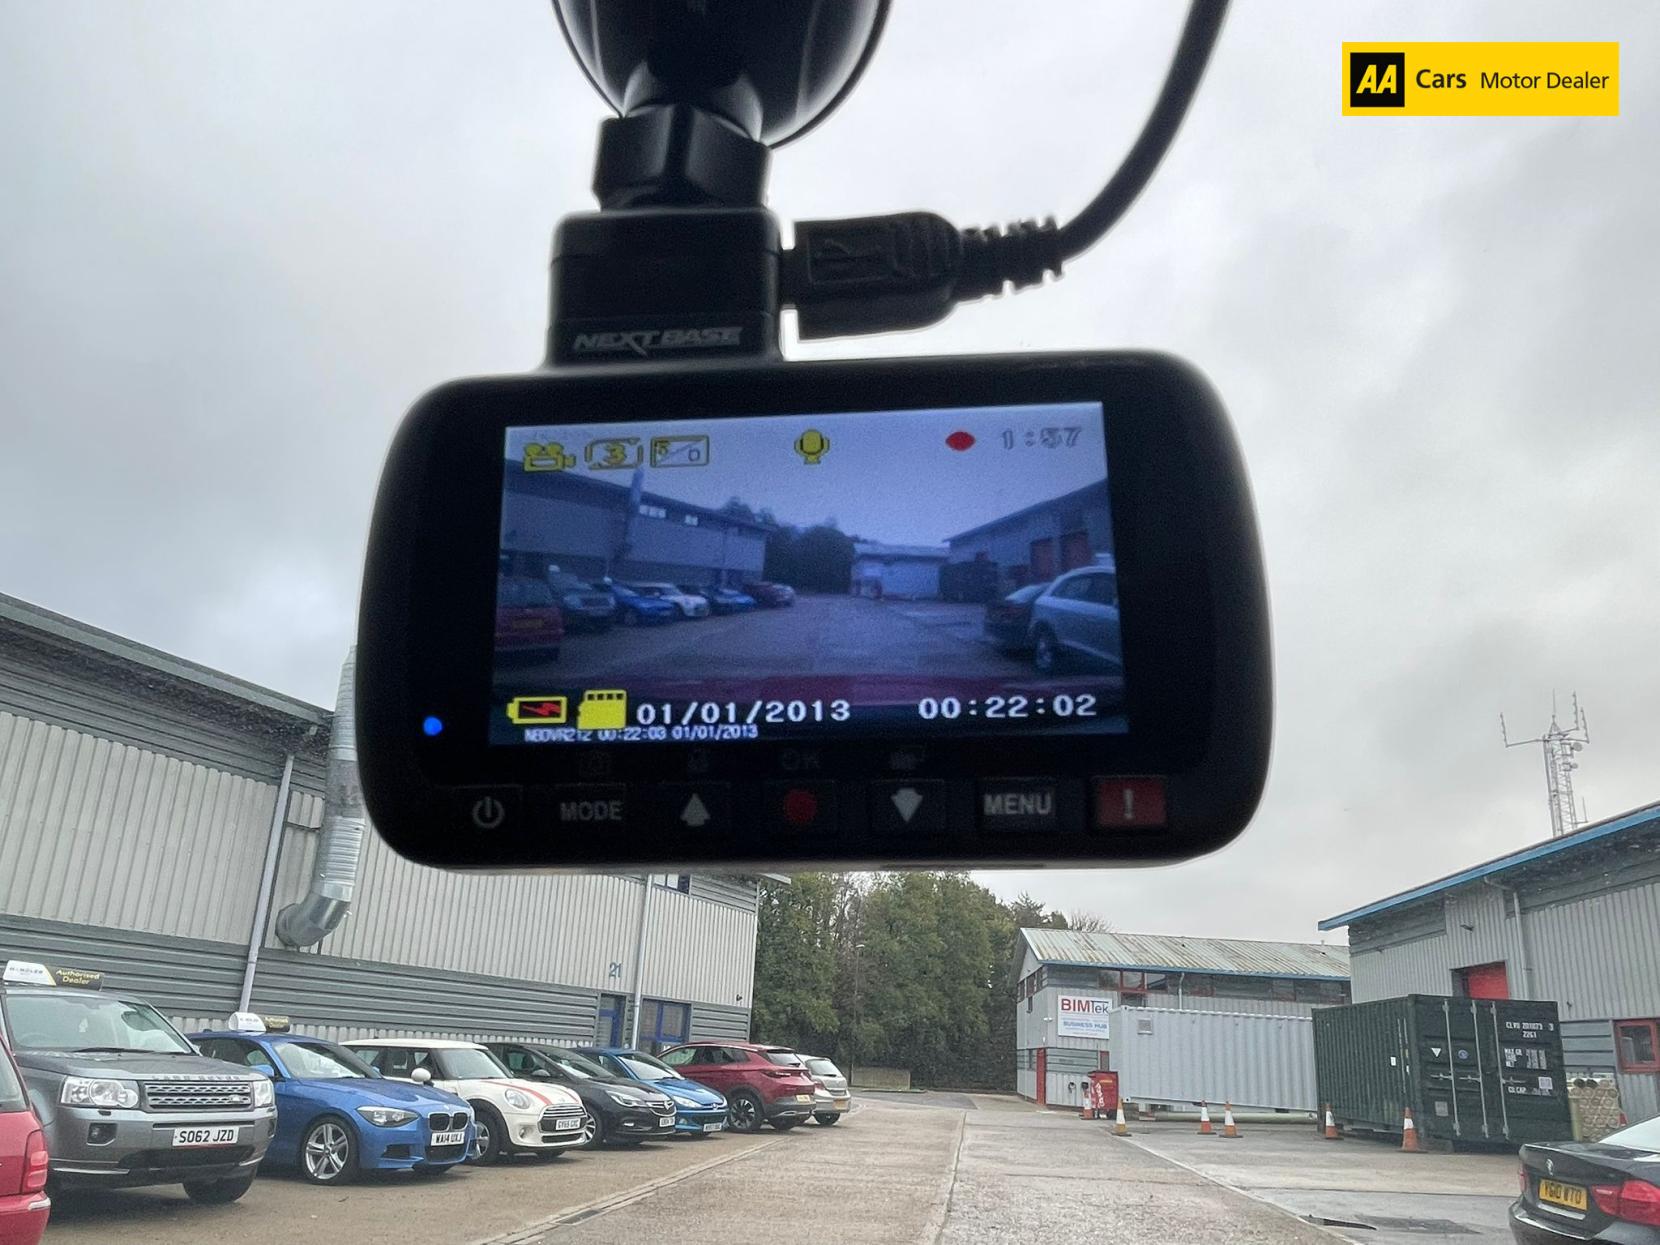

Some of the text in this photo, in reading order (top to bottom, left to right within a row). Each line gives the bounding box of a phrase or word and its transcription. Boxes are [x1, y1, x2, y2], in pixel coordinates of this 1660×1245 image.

[636, 694, 1097, 725] 01/01/2013 00:22:02
[672, 724, 759, 740] 01/01/2013
[560, 801, 622, 822] MODE
[984, 793, 1052, 815] MENU
[56, 967, 100, 980] Authorised
[609, 962, 621, 978] 21
[62, 976, 90, 985] Dealer
[1061, 998, 1109, 1014] BIMTek
[179, 1129, 235, 1144] SO62 JZD
